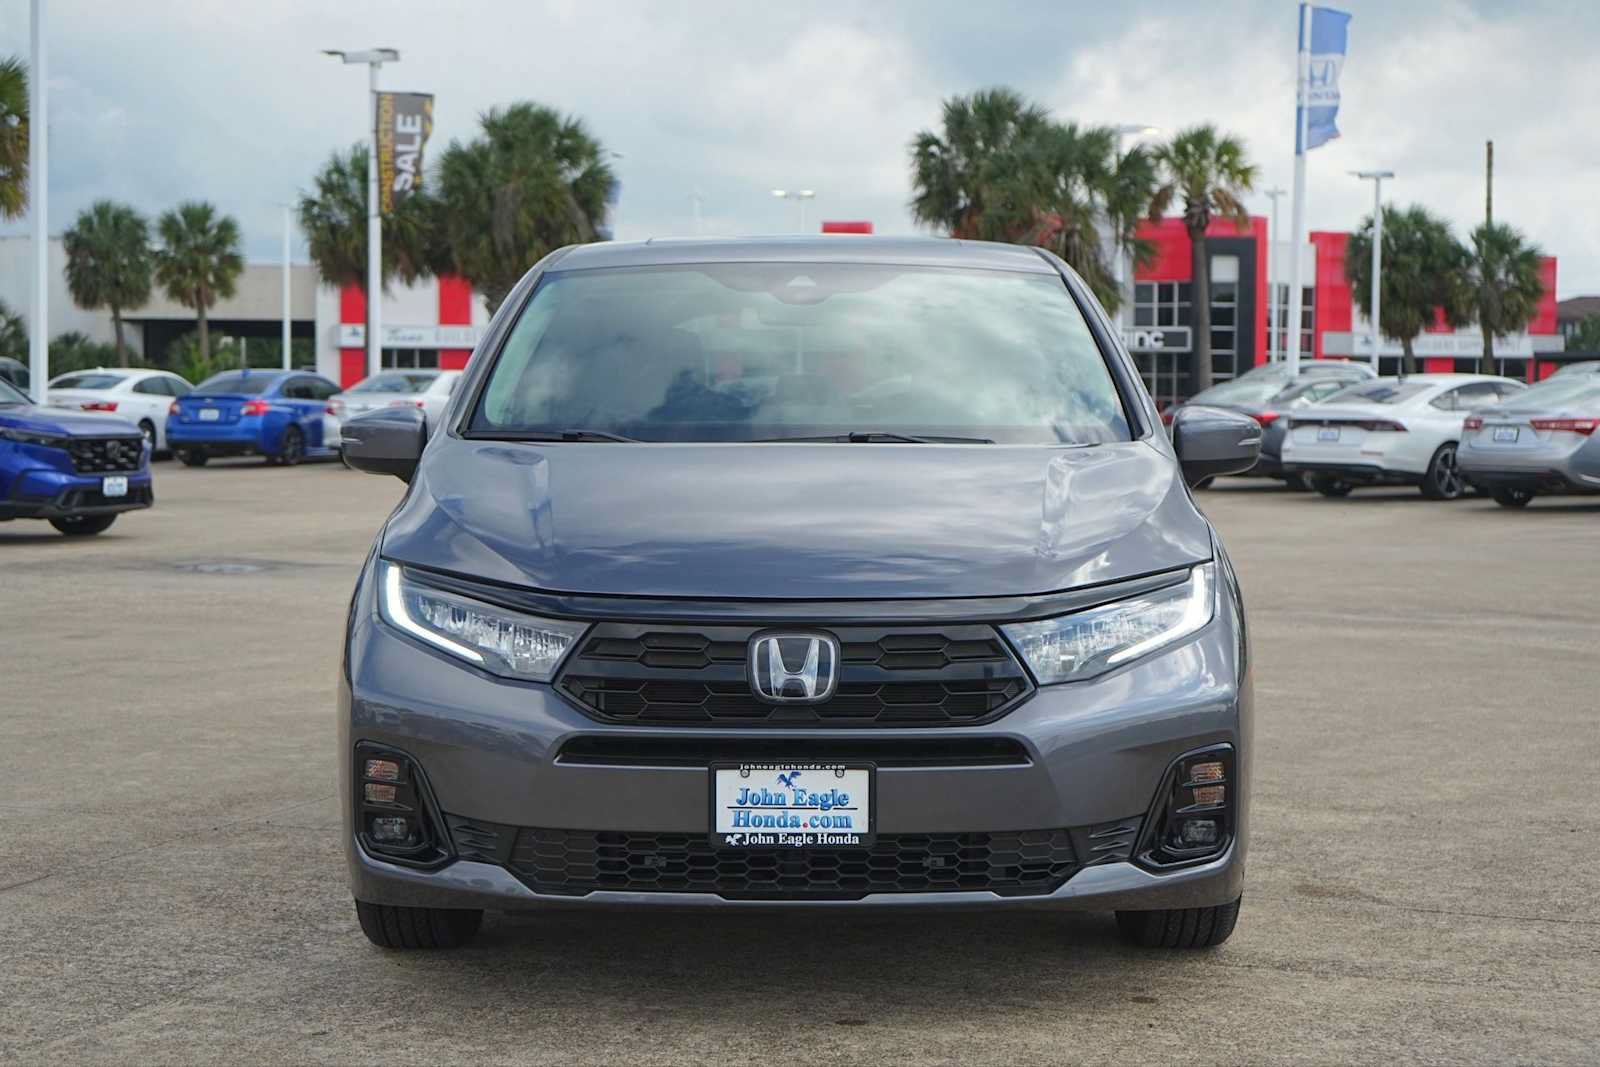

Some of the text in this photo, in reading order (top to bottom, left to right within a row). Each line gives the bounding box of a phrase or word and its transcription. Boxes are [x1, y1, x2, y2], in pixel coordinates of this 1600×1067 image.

[393, 113, 421, 192] SALE
[736, 788, 849, 811] John Eagle
[732, 810, 853, 829] Honda.com
[742, 833, 860, 847] John Eagle Honda
